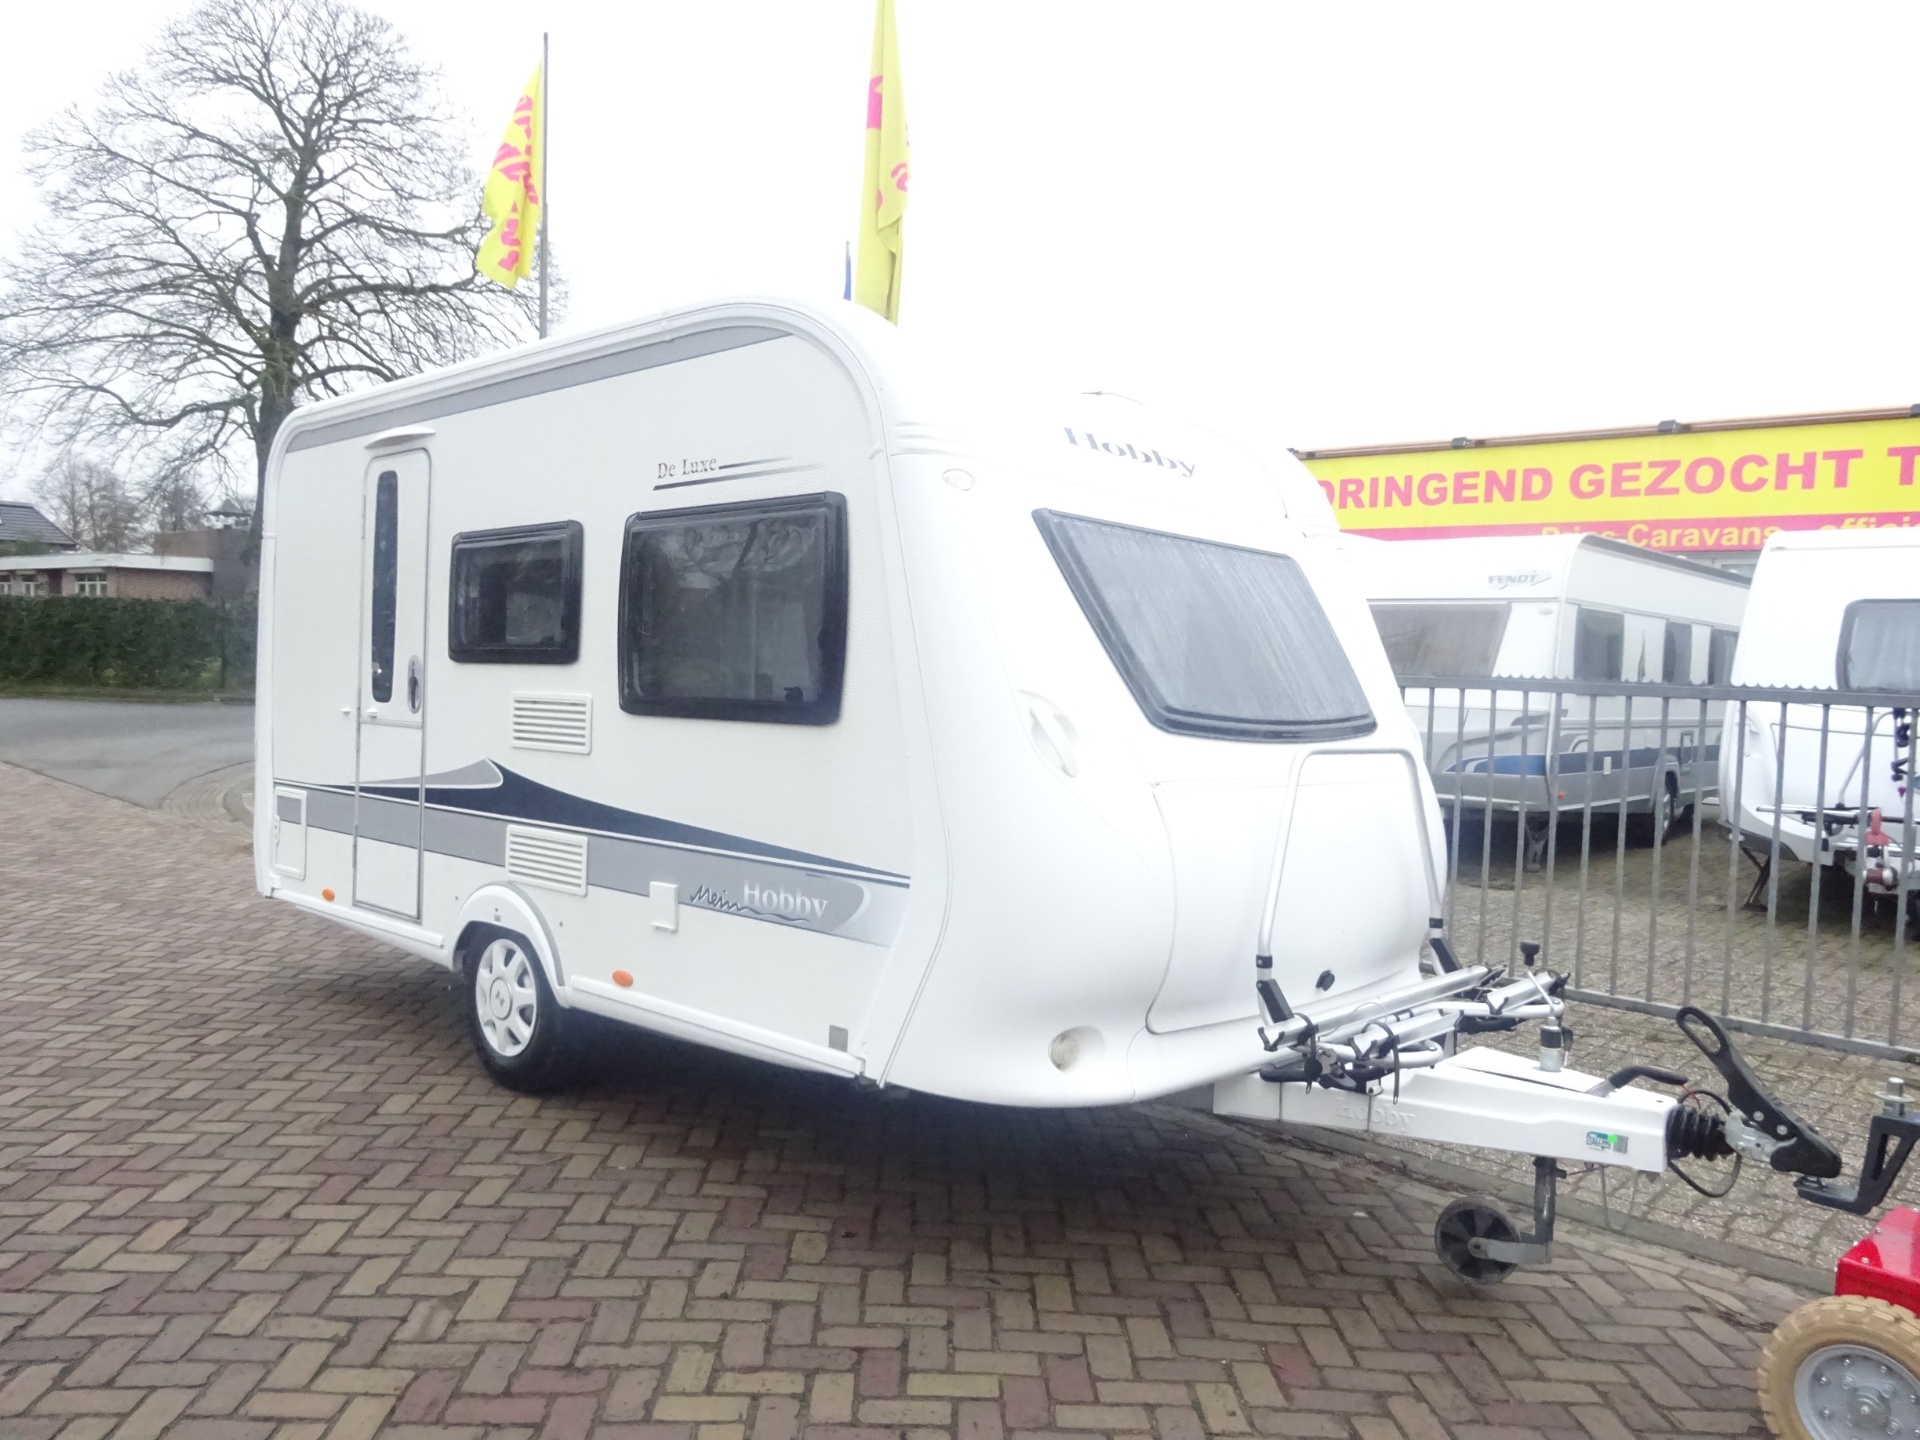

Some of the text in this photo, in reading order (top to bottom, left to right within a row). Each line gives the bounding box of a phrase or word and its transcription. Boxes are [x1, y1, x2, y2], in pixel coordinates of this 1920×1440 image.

[657, 458, 717, 479] De Luxe
[1063, 427, 1196, 478] Hobby
[1569, 449, 1864, 500] GEZOCHT
[1487, 573, 1541, 586] FENDT
[690, 880, 828, 918] Mein Hobby
